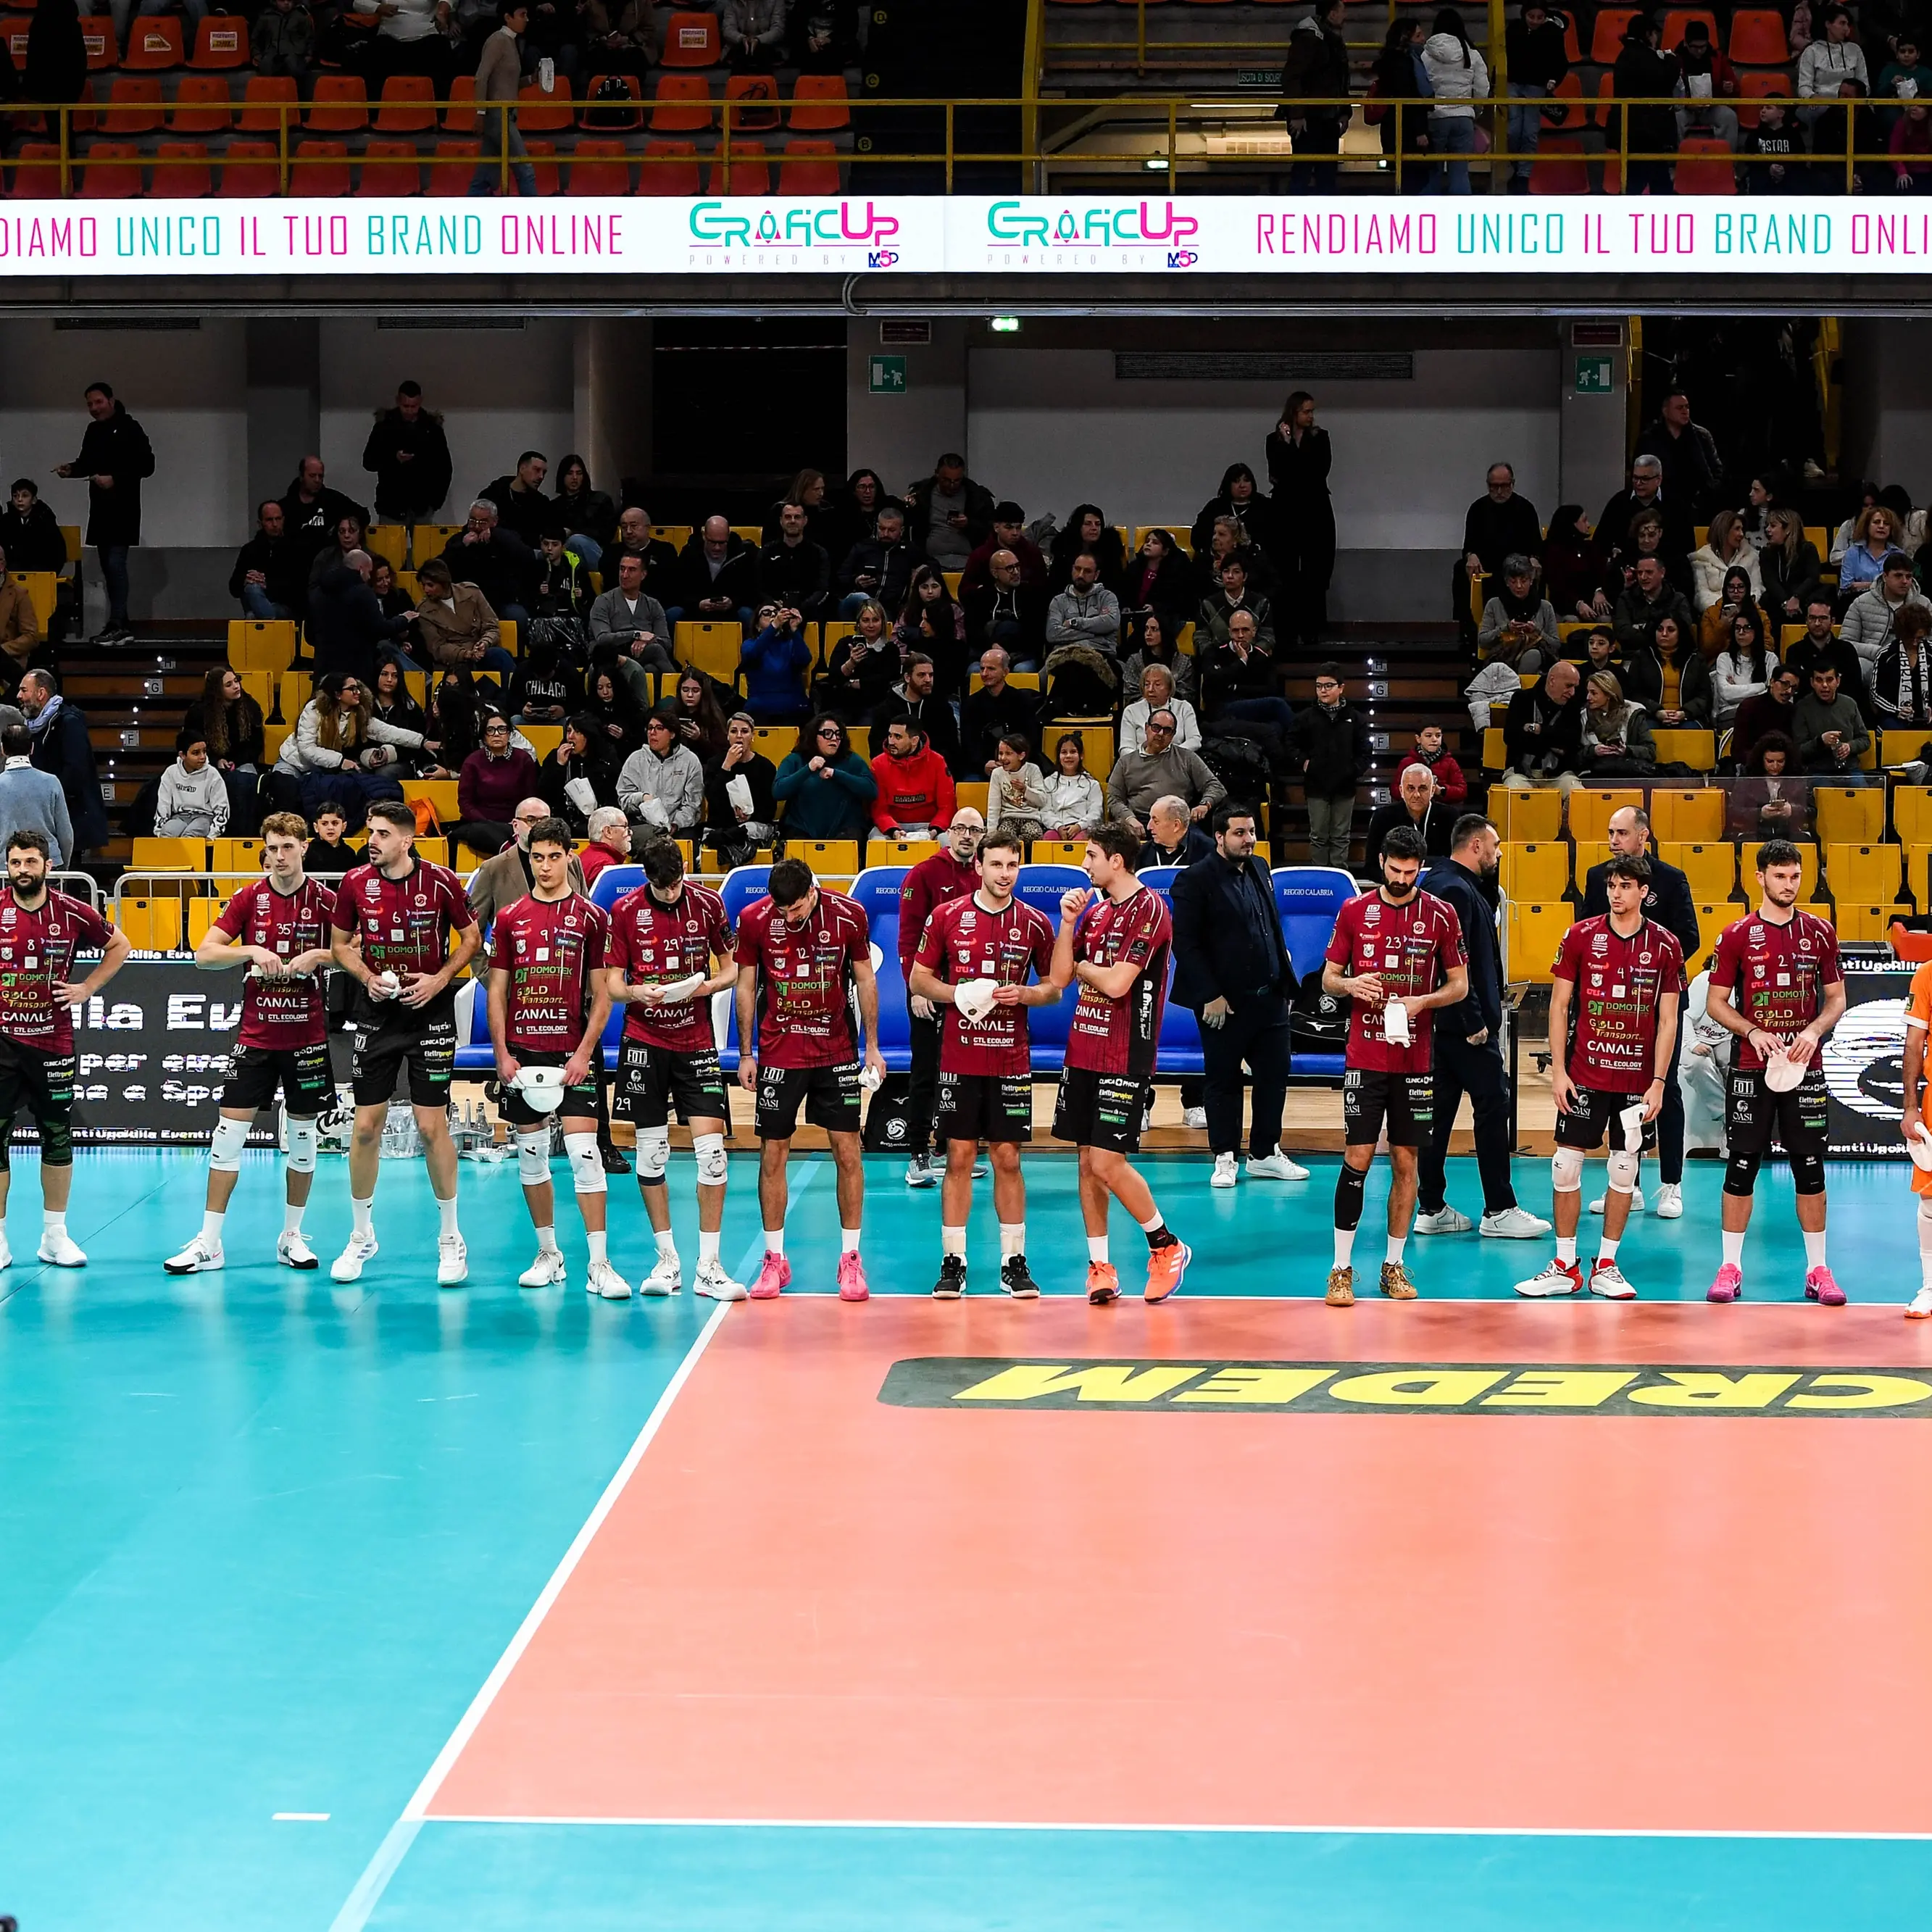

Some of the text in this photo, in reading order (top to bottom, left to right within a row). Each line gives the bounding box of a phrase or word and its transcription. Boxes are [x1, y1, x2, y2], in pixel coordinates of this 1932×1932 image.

[117, 216, 220, 257] UNICO
[241, 217, 265, 255] IL
[283, 216, 347, 255] TUO
[368, 215, 481, 255] BRAND
[501, 215, 622, 254] ONLINE
[1258, 214, 1928, 254] RENDIAMO UNICO IL TUO BRAND ONLI
[690, 254, 846, 265] POWERED BY
[988, 254, 1144, 265] POWERED BY
[525, 680, 567, 698] CHICAGO
[393, 912, 401, 923] 6
[276, 923, 291, 936] 35
[540, 930, 549, 941] 9
[28, 939, 35, 951] 8
[663, 939, 680, 951] 29
[985, 942, 994, 954] 5
[1386, 936, 1402, 949] 23
[388, 944, 430, 954] DOMOTEK
[796, 947, 809, 959] 12
[1778, 954, 1789, 967] 2
[530, 966, 572, 976] DOMOTEK
[1617, 967, 1624, 979] 4
[516, 986, 548, 996] GOLD
[256, 996, 309, 1009] CANALE
[1606, 1002, 1650, 1012] DOMOTEK
[515, 1009, 567, 1020] CANALE
[1075, 1005, 1112, 1022] CANALE
[1754, 1009, 1793, 1020] GOLD
[958, 1019, 1015, 1033] CANALE
[1589, 1018, 1625, 1030] GOLD
[1763, 1018, 1807, 1028] Transport
[1596, 1028, 1640, 1040] Transport
[1587, 1040, 1644, 1055] CANALE
[626, 1081, 645, 1091] OASI
[616, 1096, 631, 1111] 29
[1570, 1105, 1591, 1117] OASI
[1733, 1112, 1752, 1122] OASI
[1559, 1119, 1565, 1133] 4
[951, 1365, 1932, 1410] CREDEM
